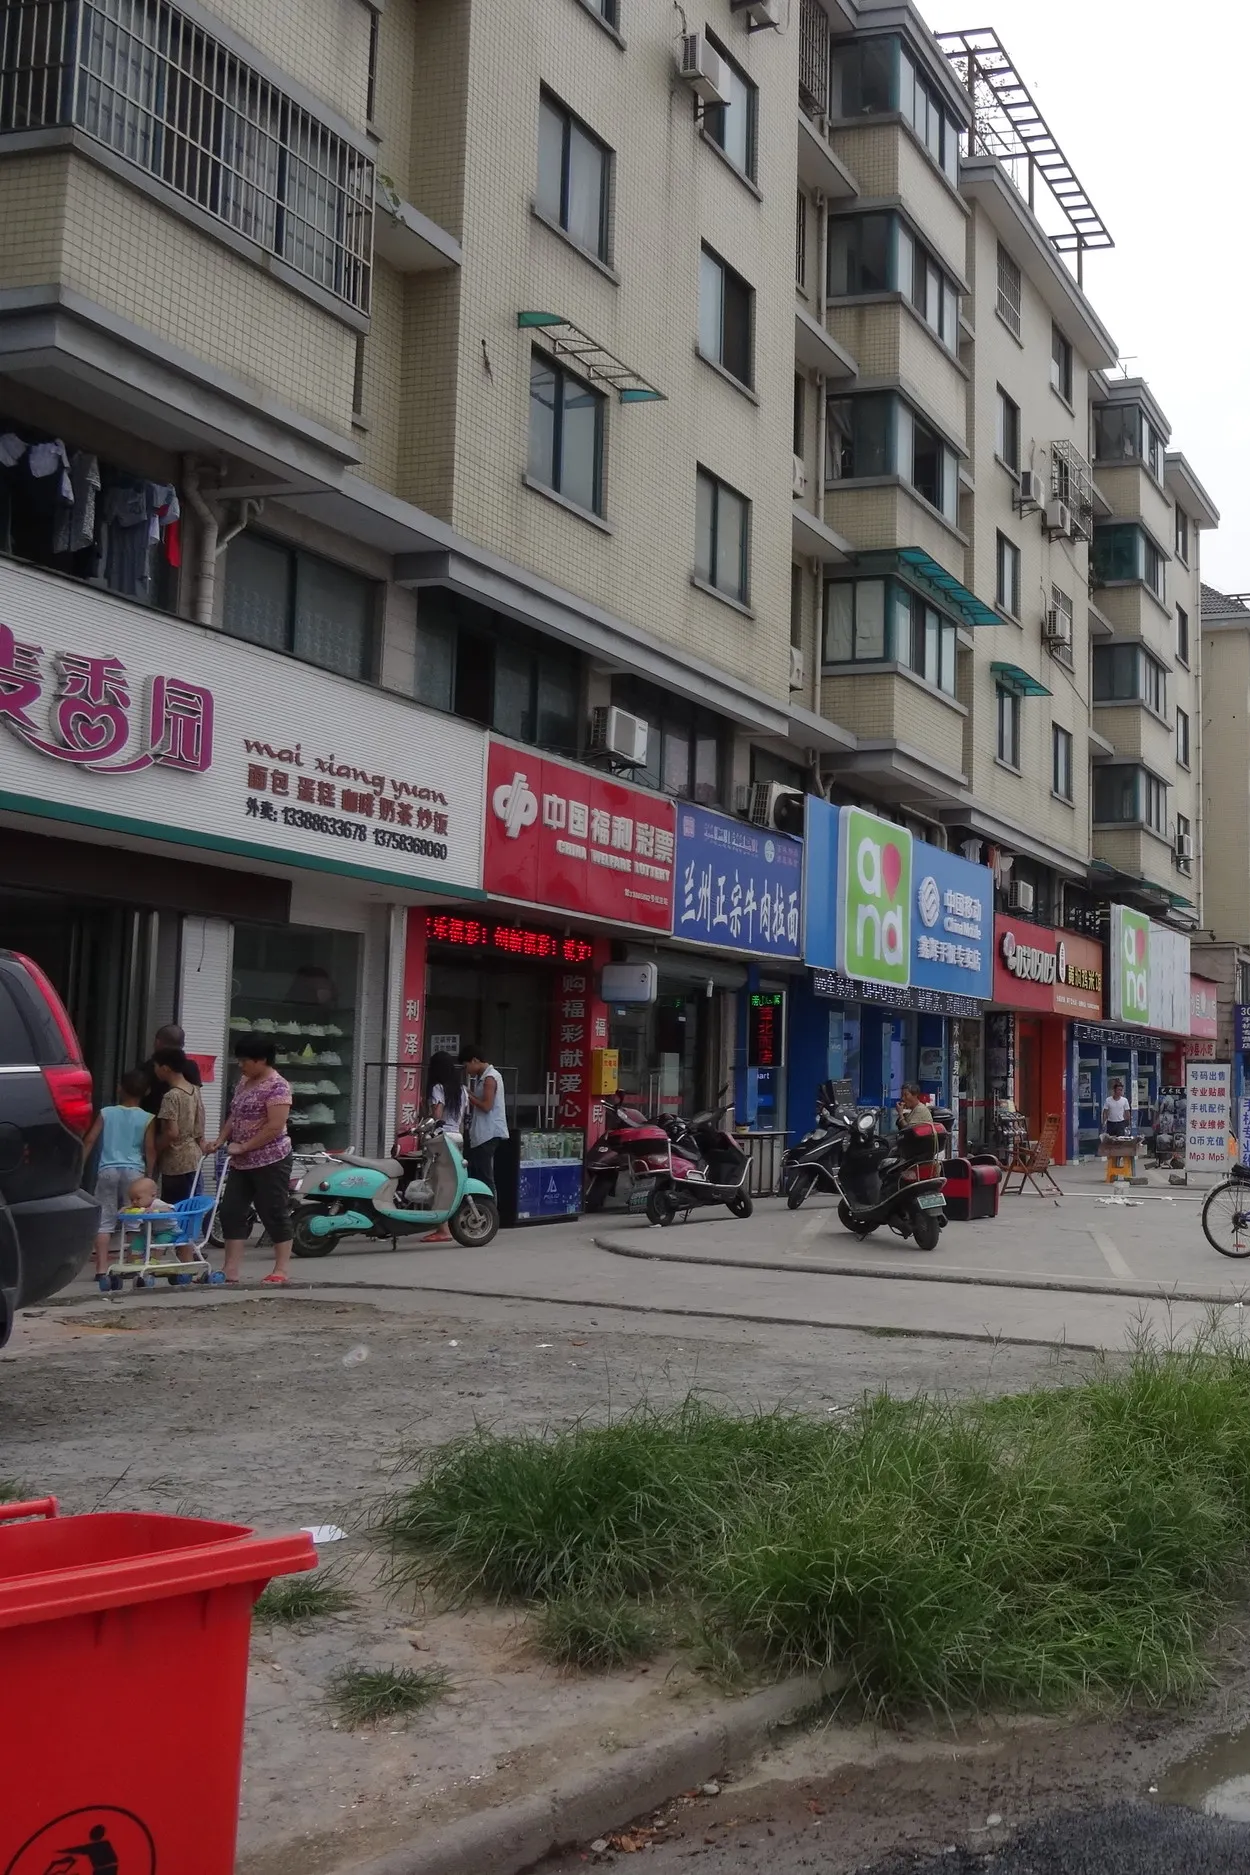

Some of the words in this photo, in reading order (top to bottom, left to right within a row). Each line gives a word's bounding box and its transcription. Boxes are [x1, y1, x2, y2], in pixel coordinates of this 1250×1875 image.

[244, 739, 304, 766] mai
[315, 754, 385, 796] xiang
[391, 779, 448, 806] yuan
[248, 763, 289, 796] 面包
[298, 776, 336, 808] 蛋糕
[342, 789, 375, 818] 咖啡
[379, 797, 413, 828] 奶茶
[417, 807, 448, 836] 炒饭
[282, 806, 367, 841] 13388633678
[372, 828, 447, 860] 13758368060
[543, 794, 674, 863] 中国福利彩票
[557, 840, 587, 860] CHINA
[591, 849, 631, 873] WELFARE
[634, 861, 670, 882] LOTTERY
[681, 860, 799, 946] 兰州正宗牛肉拉面
[944, 889, 982, 922] 中国移动
[559, 975, 586, 1128] 购福彩献爱心
[1190, 1071, 1225, 1081] 号码出售
[1190, 1087, 1225, 1097] 专业贴膜
[1190, 1103, 1225, 1113] 手机配件
[1190, 1119, 1225, 1130] 专业维修
[1189, 1136, 1224, 1146] Q币充值
[1189, 1152, 1205, 1161] Mp3
[1208, 1153, 1224, 1161] Mp5
